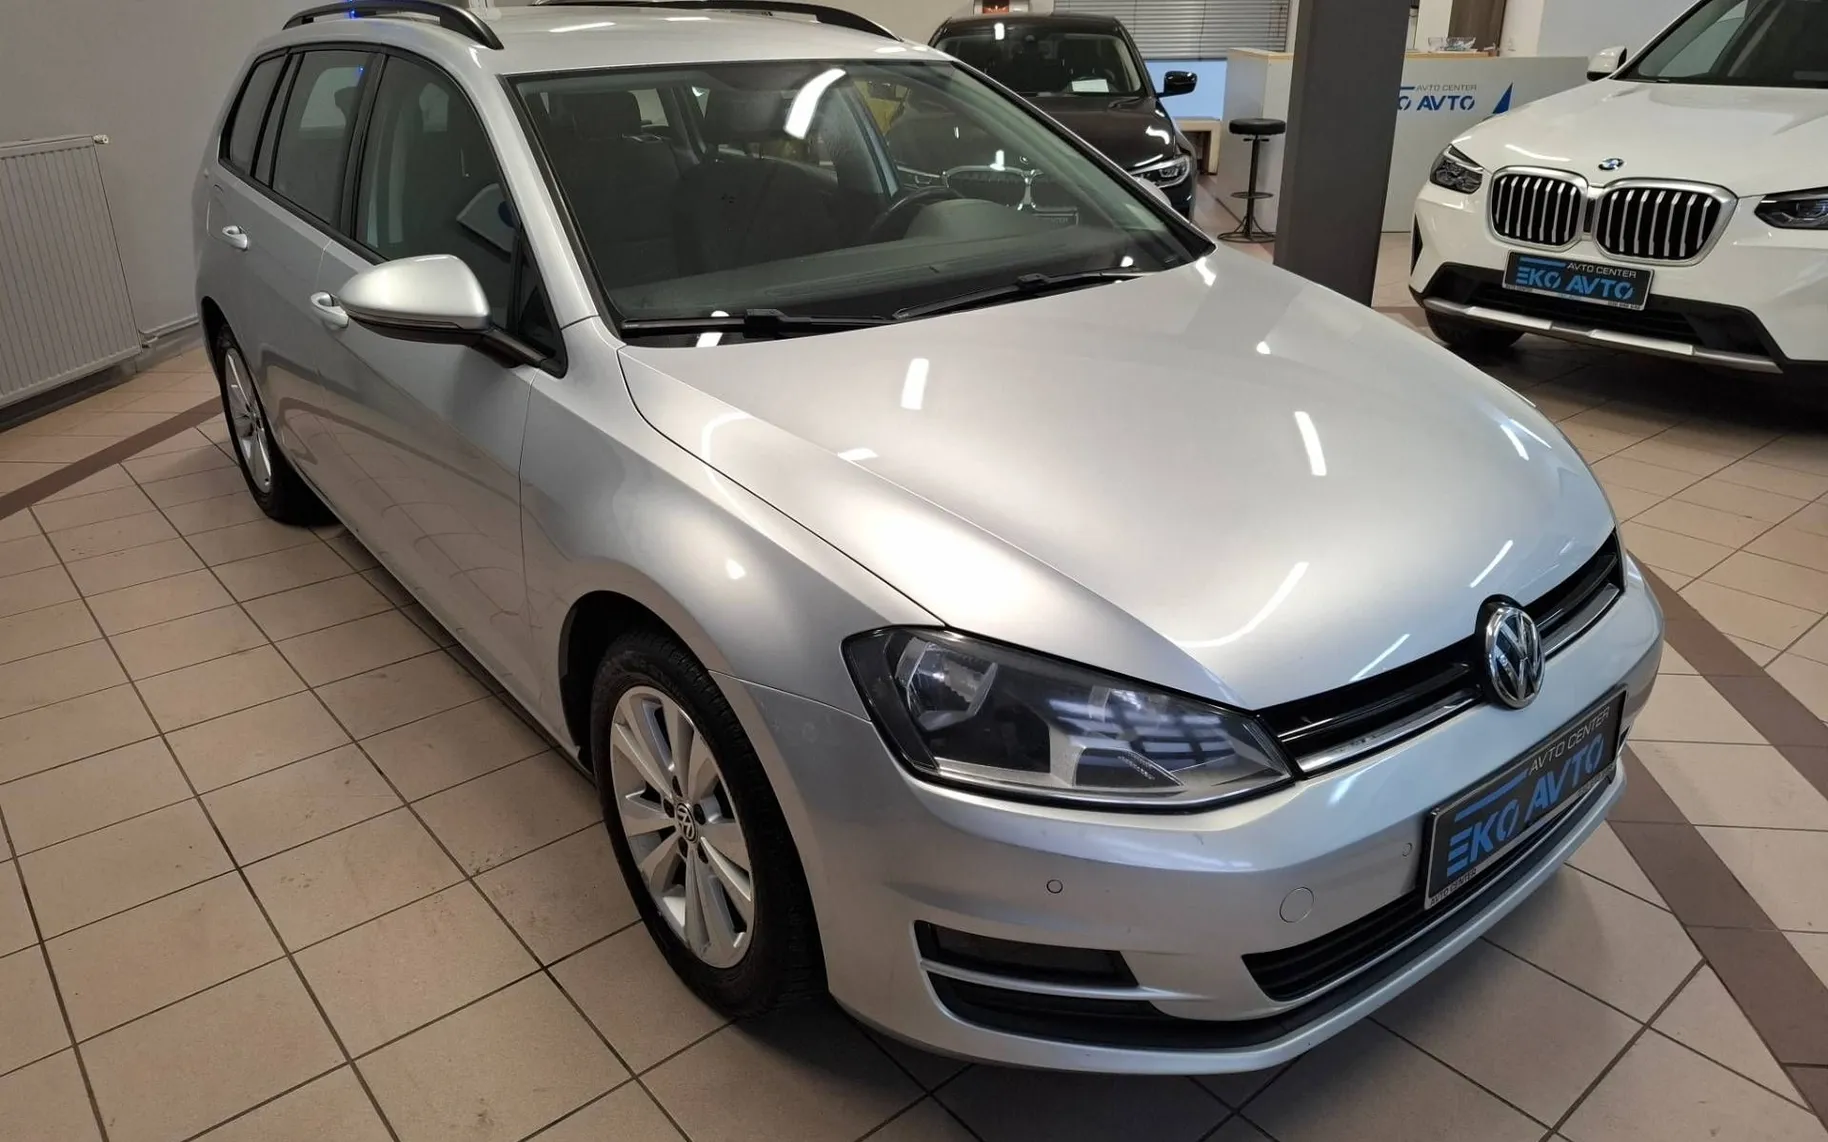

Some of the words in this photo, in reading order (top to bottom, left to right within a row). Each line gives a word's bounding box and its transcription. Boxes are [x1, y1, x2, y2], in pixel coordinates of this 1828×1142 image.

[1416, 84, 1440, 92] AVTO
[1442, 84, 1478, 92] CENTER
[1416, 95, 1475, 111] AVTO
[1515, 266, 1561, 289] EKO
[1566, 275, 1634, 300] AVTO
[1567, 262, 1595, 274] AVTO
[1596, 266, 1637, 279] CENTER
[1529, 741, 1565, 774] AVTO
[1567, 706, 1611, 749] CENTER
[1446, 799, 1520, 877] EKO
[1524, 733, 1604, 823] AVTO
